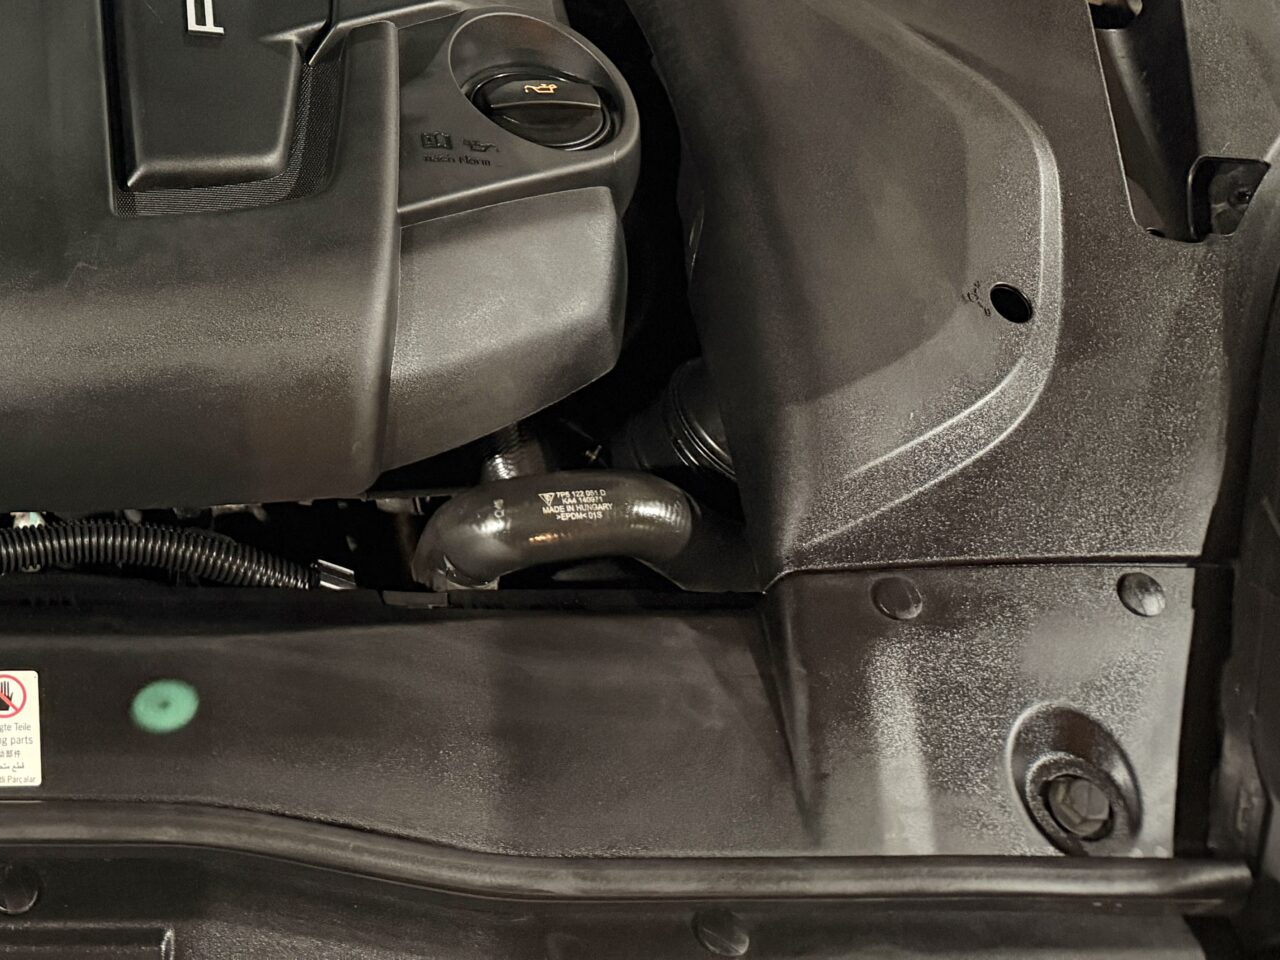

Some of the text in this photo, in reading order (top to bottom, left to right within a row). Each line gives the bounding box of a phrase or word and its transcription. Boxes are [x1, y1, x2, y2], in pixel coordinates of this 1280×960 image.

[542, 506, 565, 514] MADE
[575, 503, 613, 512] HUNGARY
[14, 722, 32, 731] Teile
[10, 736, 34, 746] parts
